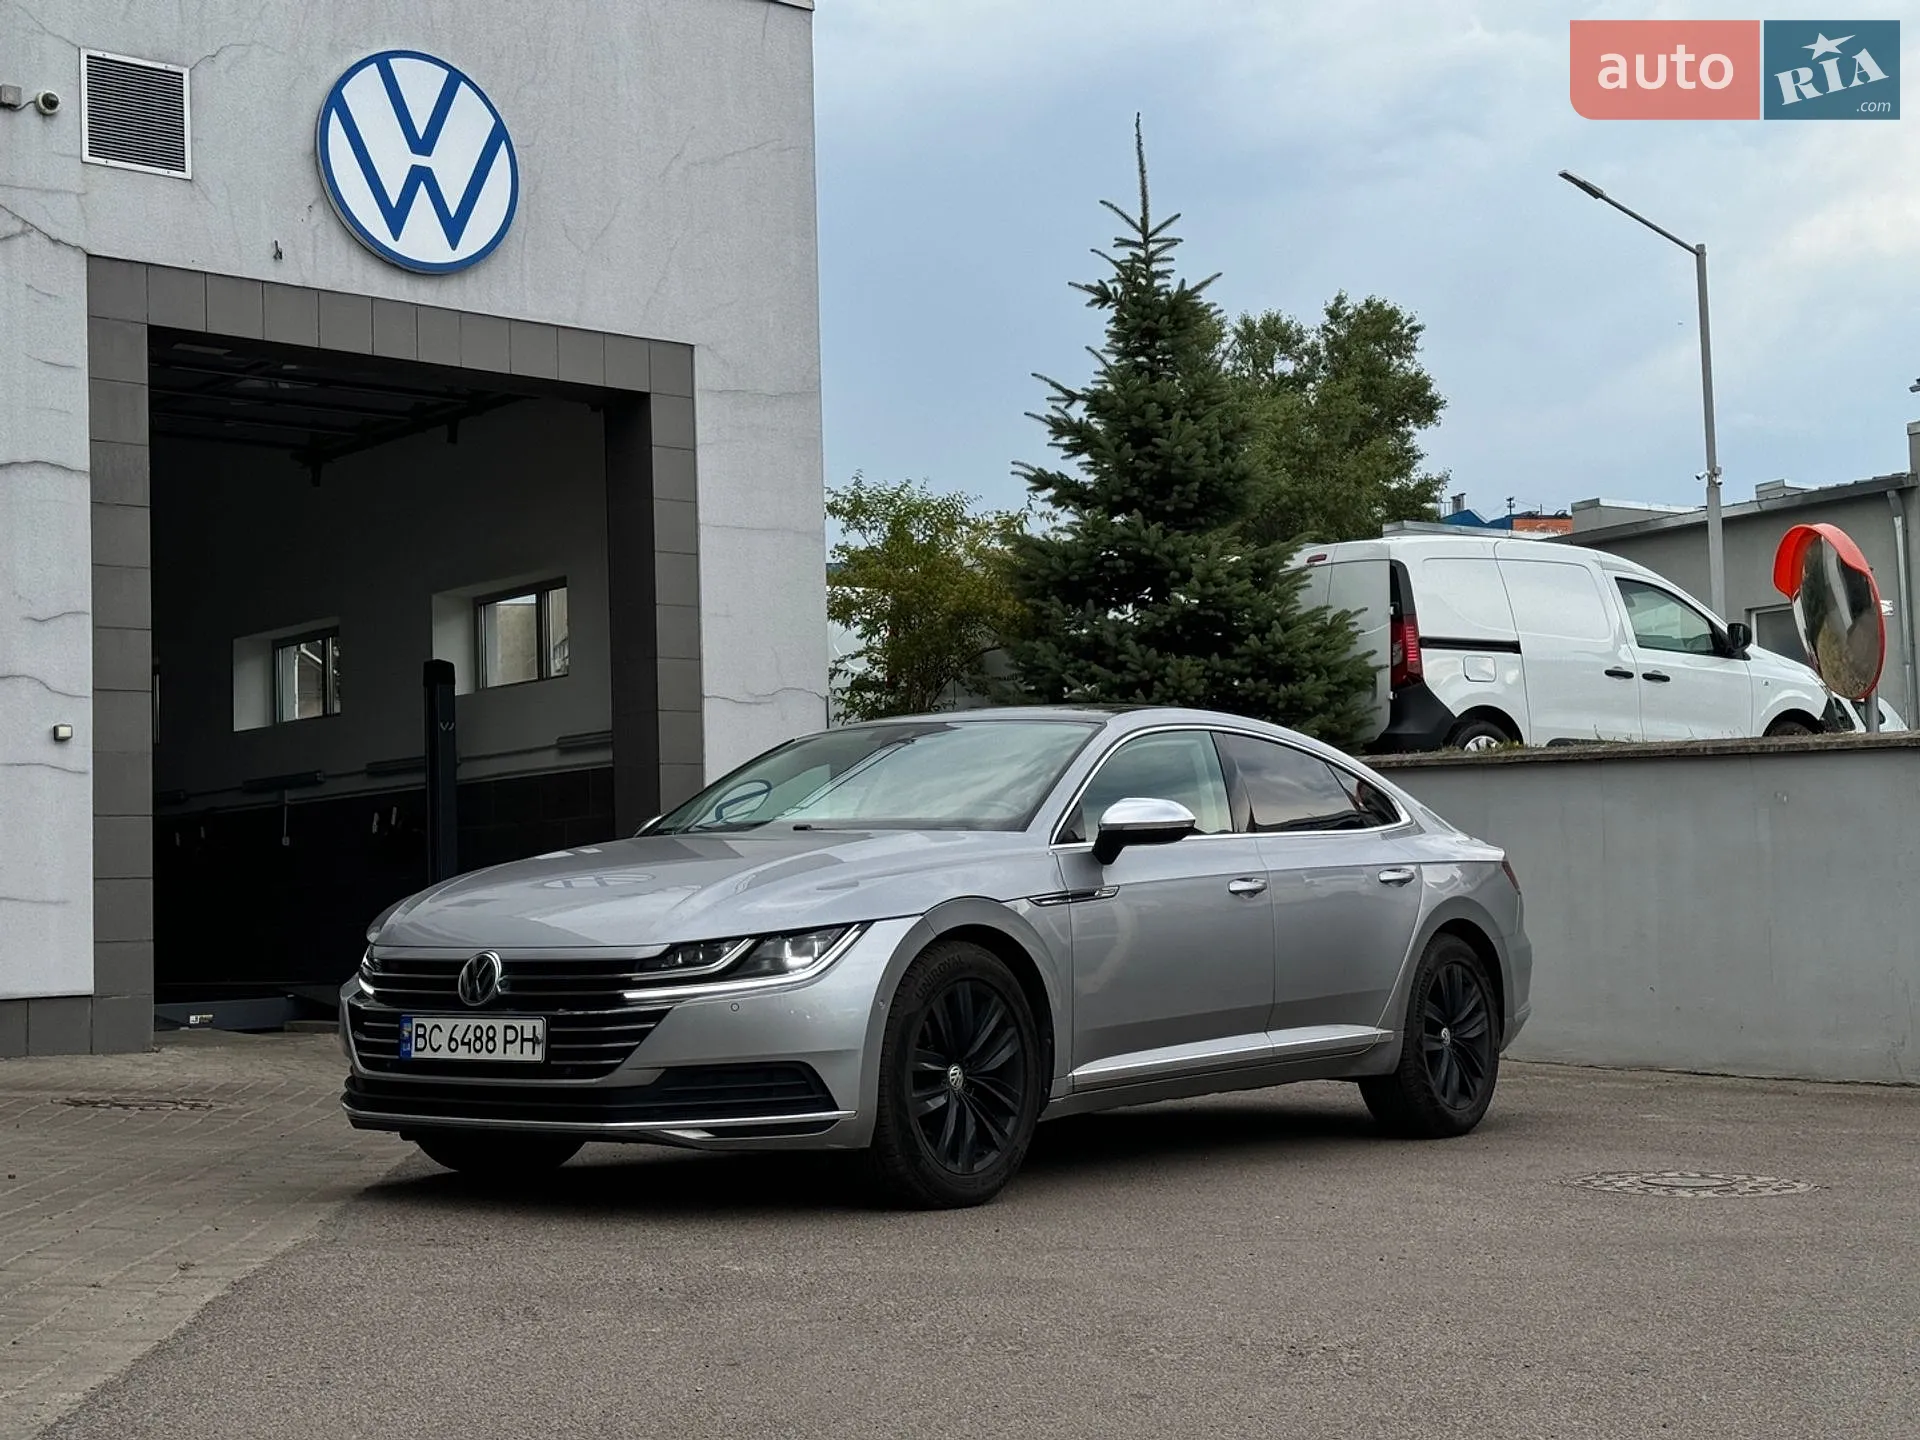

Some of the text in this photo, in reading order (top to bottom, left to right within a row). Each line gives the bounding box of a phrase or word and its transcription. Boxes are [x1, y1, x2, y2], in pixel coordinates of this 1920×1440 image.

[415, 1023, 537, 1055] BC 6488 PH
